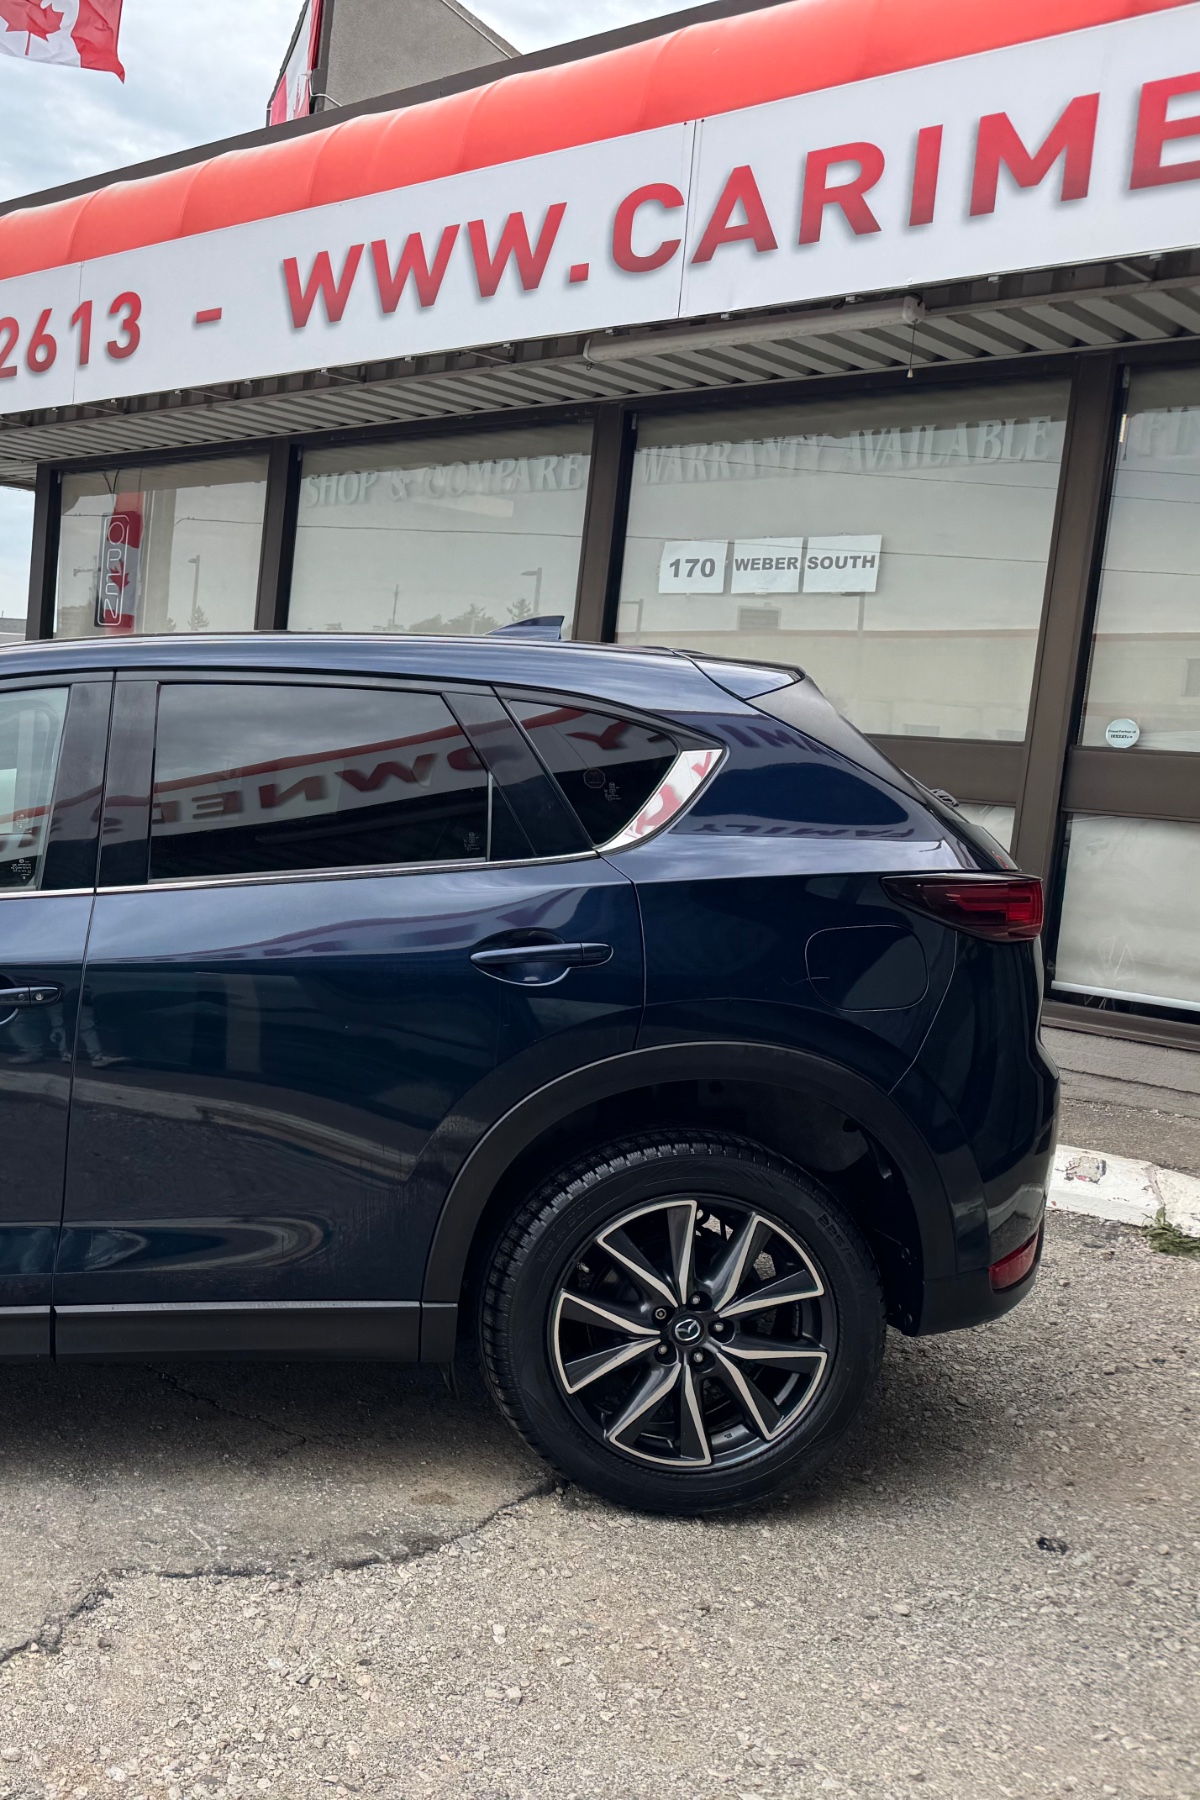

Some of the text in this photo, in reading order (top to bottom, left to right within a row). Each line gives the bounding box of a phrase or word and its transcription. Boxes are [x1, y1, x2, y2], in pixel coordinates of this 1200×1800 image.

[848, 415, 1052, 472] AVAILABLE
[303, 470, 378, 507] SHOP
[422, 453, 583, 498] COMPARE
[103, 521, 125, 619] OPEN
[669, 555, 876, 578] 170 WEBER SOUTH
